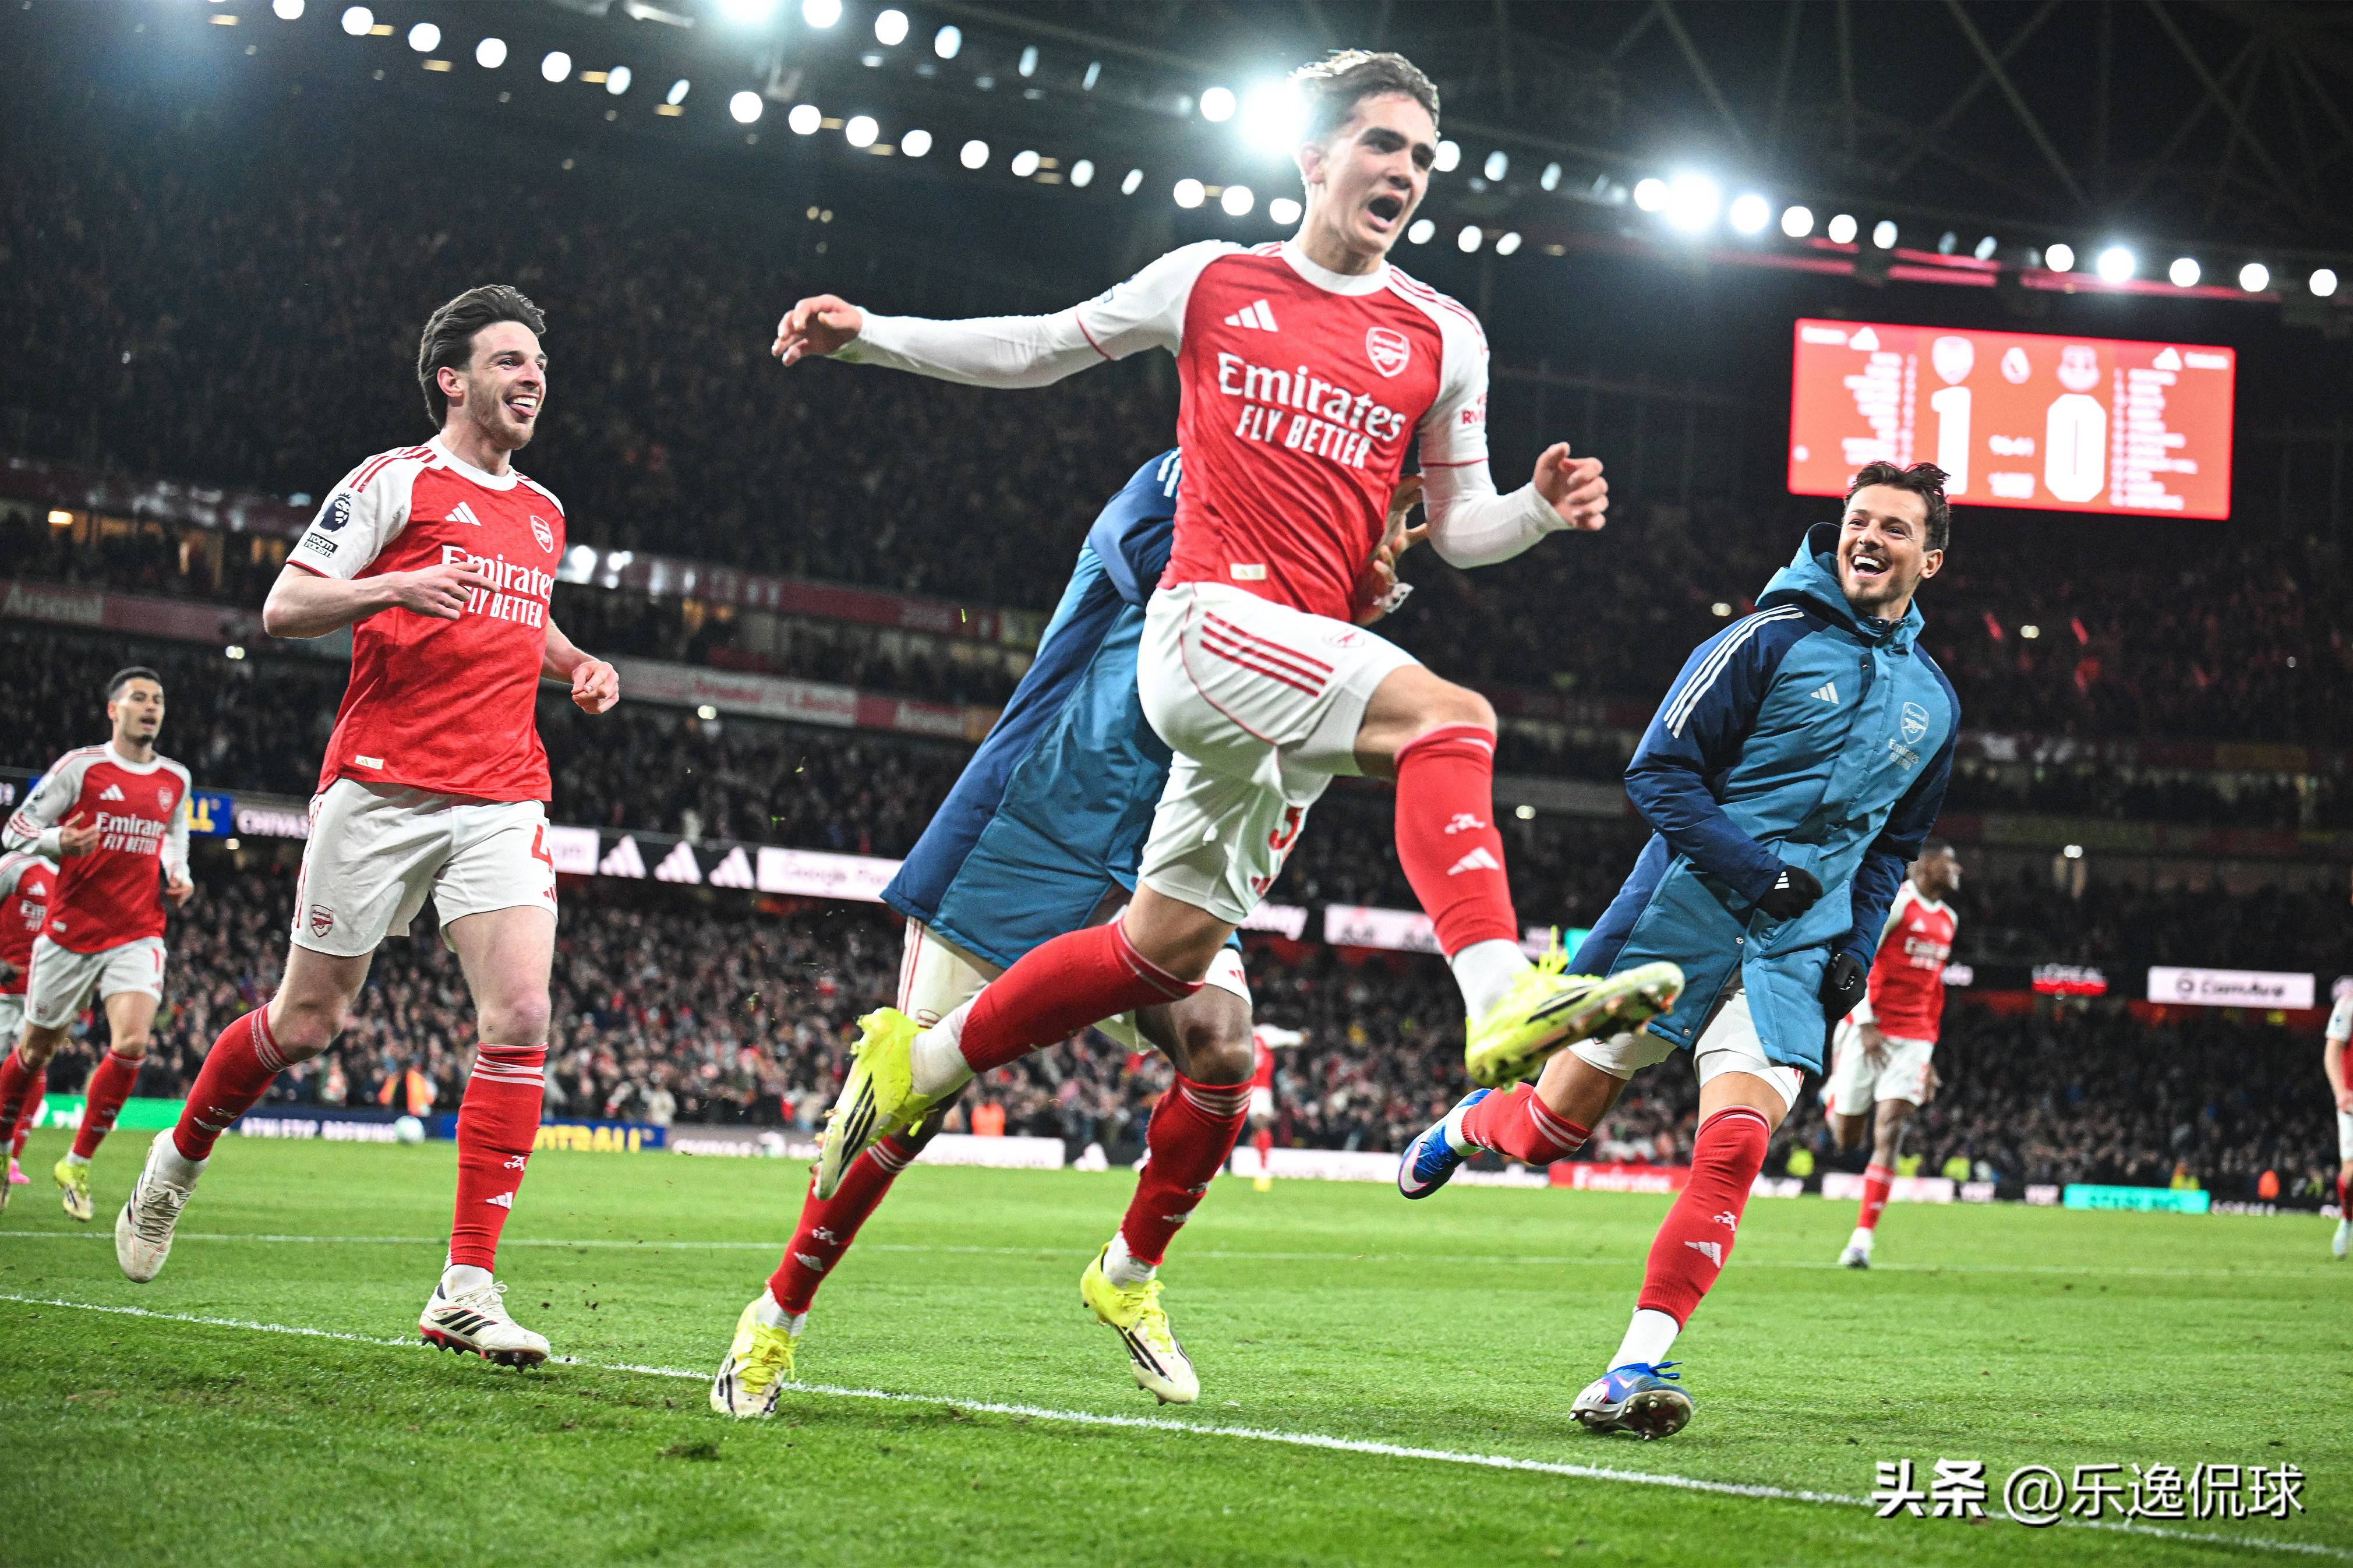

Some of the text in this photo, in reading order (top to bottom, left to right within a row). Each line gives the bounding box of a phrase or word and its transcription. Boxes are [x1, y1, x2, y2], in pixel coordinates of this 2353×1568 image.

[1218, 352, 1406, 442] Emirates
[1235, 404, 1373, 469] FLY BETTER
[1931, 387, 1971, 495] 1
[2045, 394, 2107, 503] 0
[464, 585, 543, 629] LY BETTER
